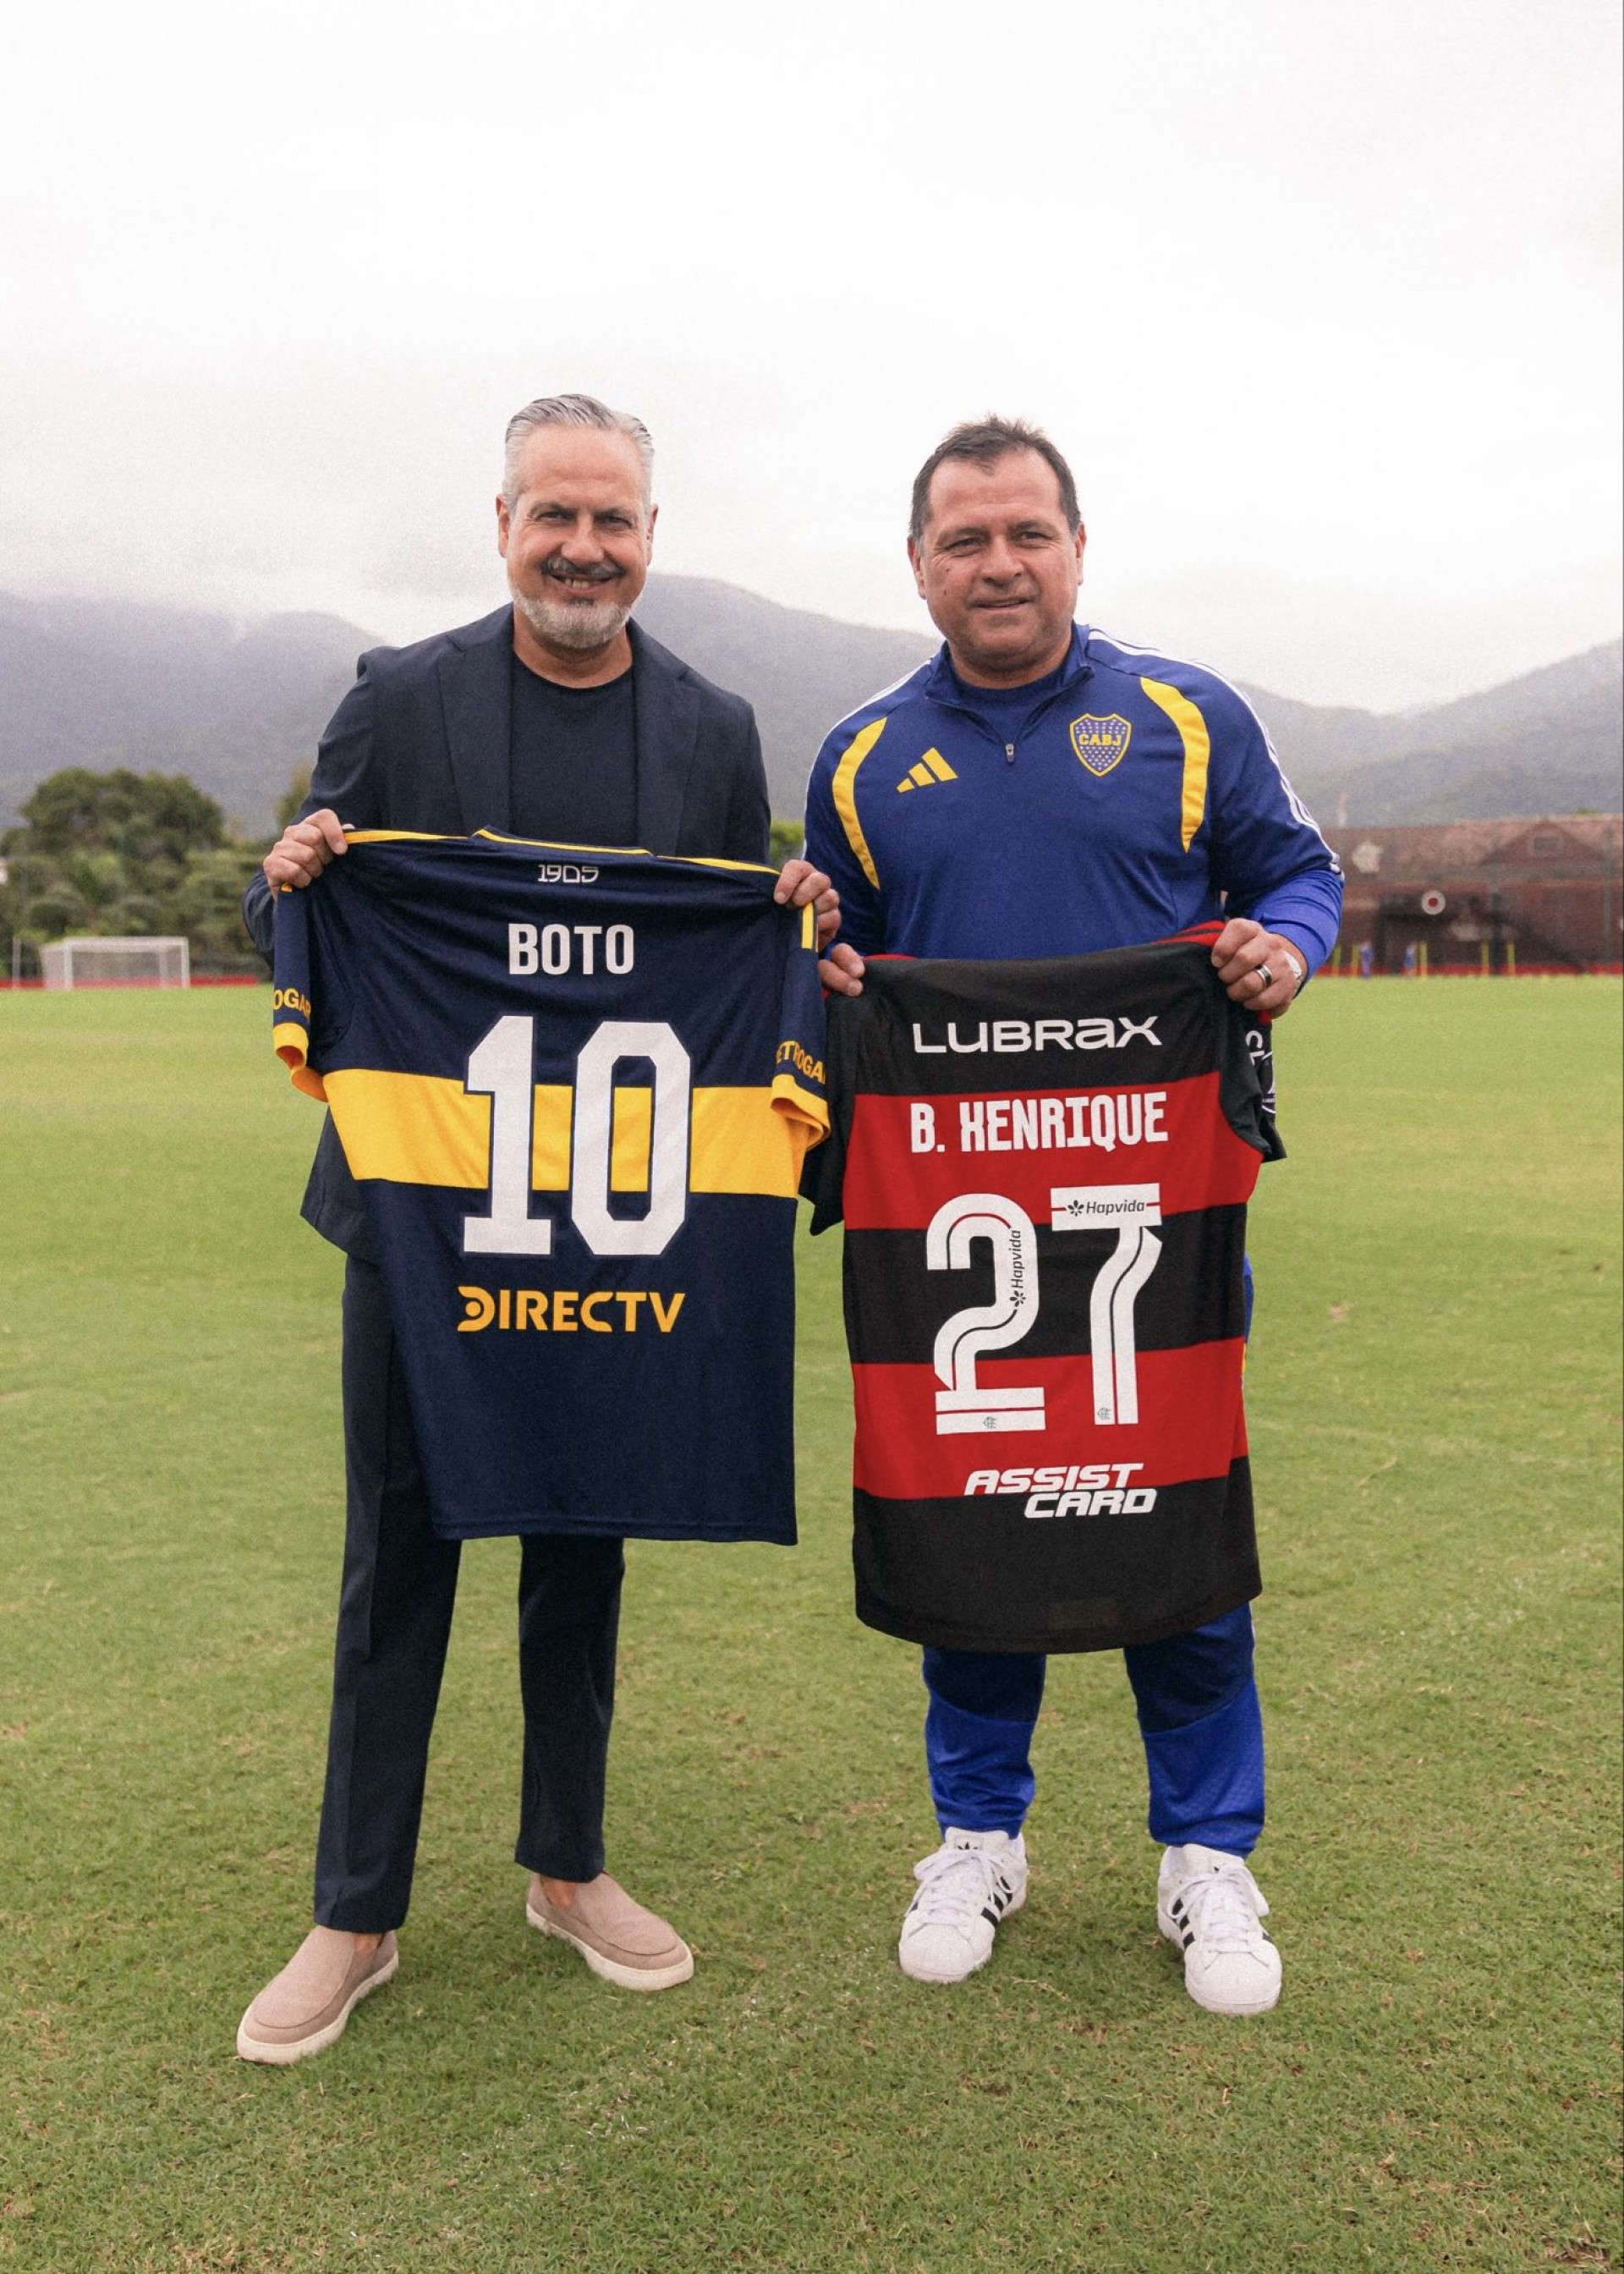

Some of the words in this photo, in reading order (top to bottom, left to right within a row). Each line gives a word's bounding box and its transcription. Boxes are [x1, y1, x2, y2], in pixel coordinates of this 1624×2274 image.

[1078, 733, 1122, 746] CABJ
[537, 865, 599, 883] 1905
[508, 923, 634, 975] BOTO
[464, 1015, 691, 1255] 10
[910, 1102, 945, 1153] B.
[960, 1091, 1169, 1152] HENRIQUE
[1086, 1200, 1144, 1216] Hapvida
[1009, 1229, 1025, 1289] Hapvida
[457, 1286, 685, 1332] DIRECTV
[926, 1183, 1163, 1436] 27
[964, 1463, 1144, 1496] ASSIST
[1024, 1488, 1158, 1519] CARD
